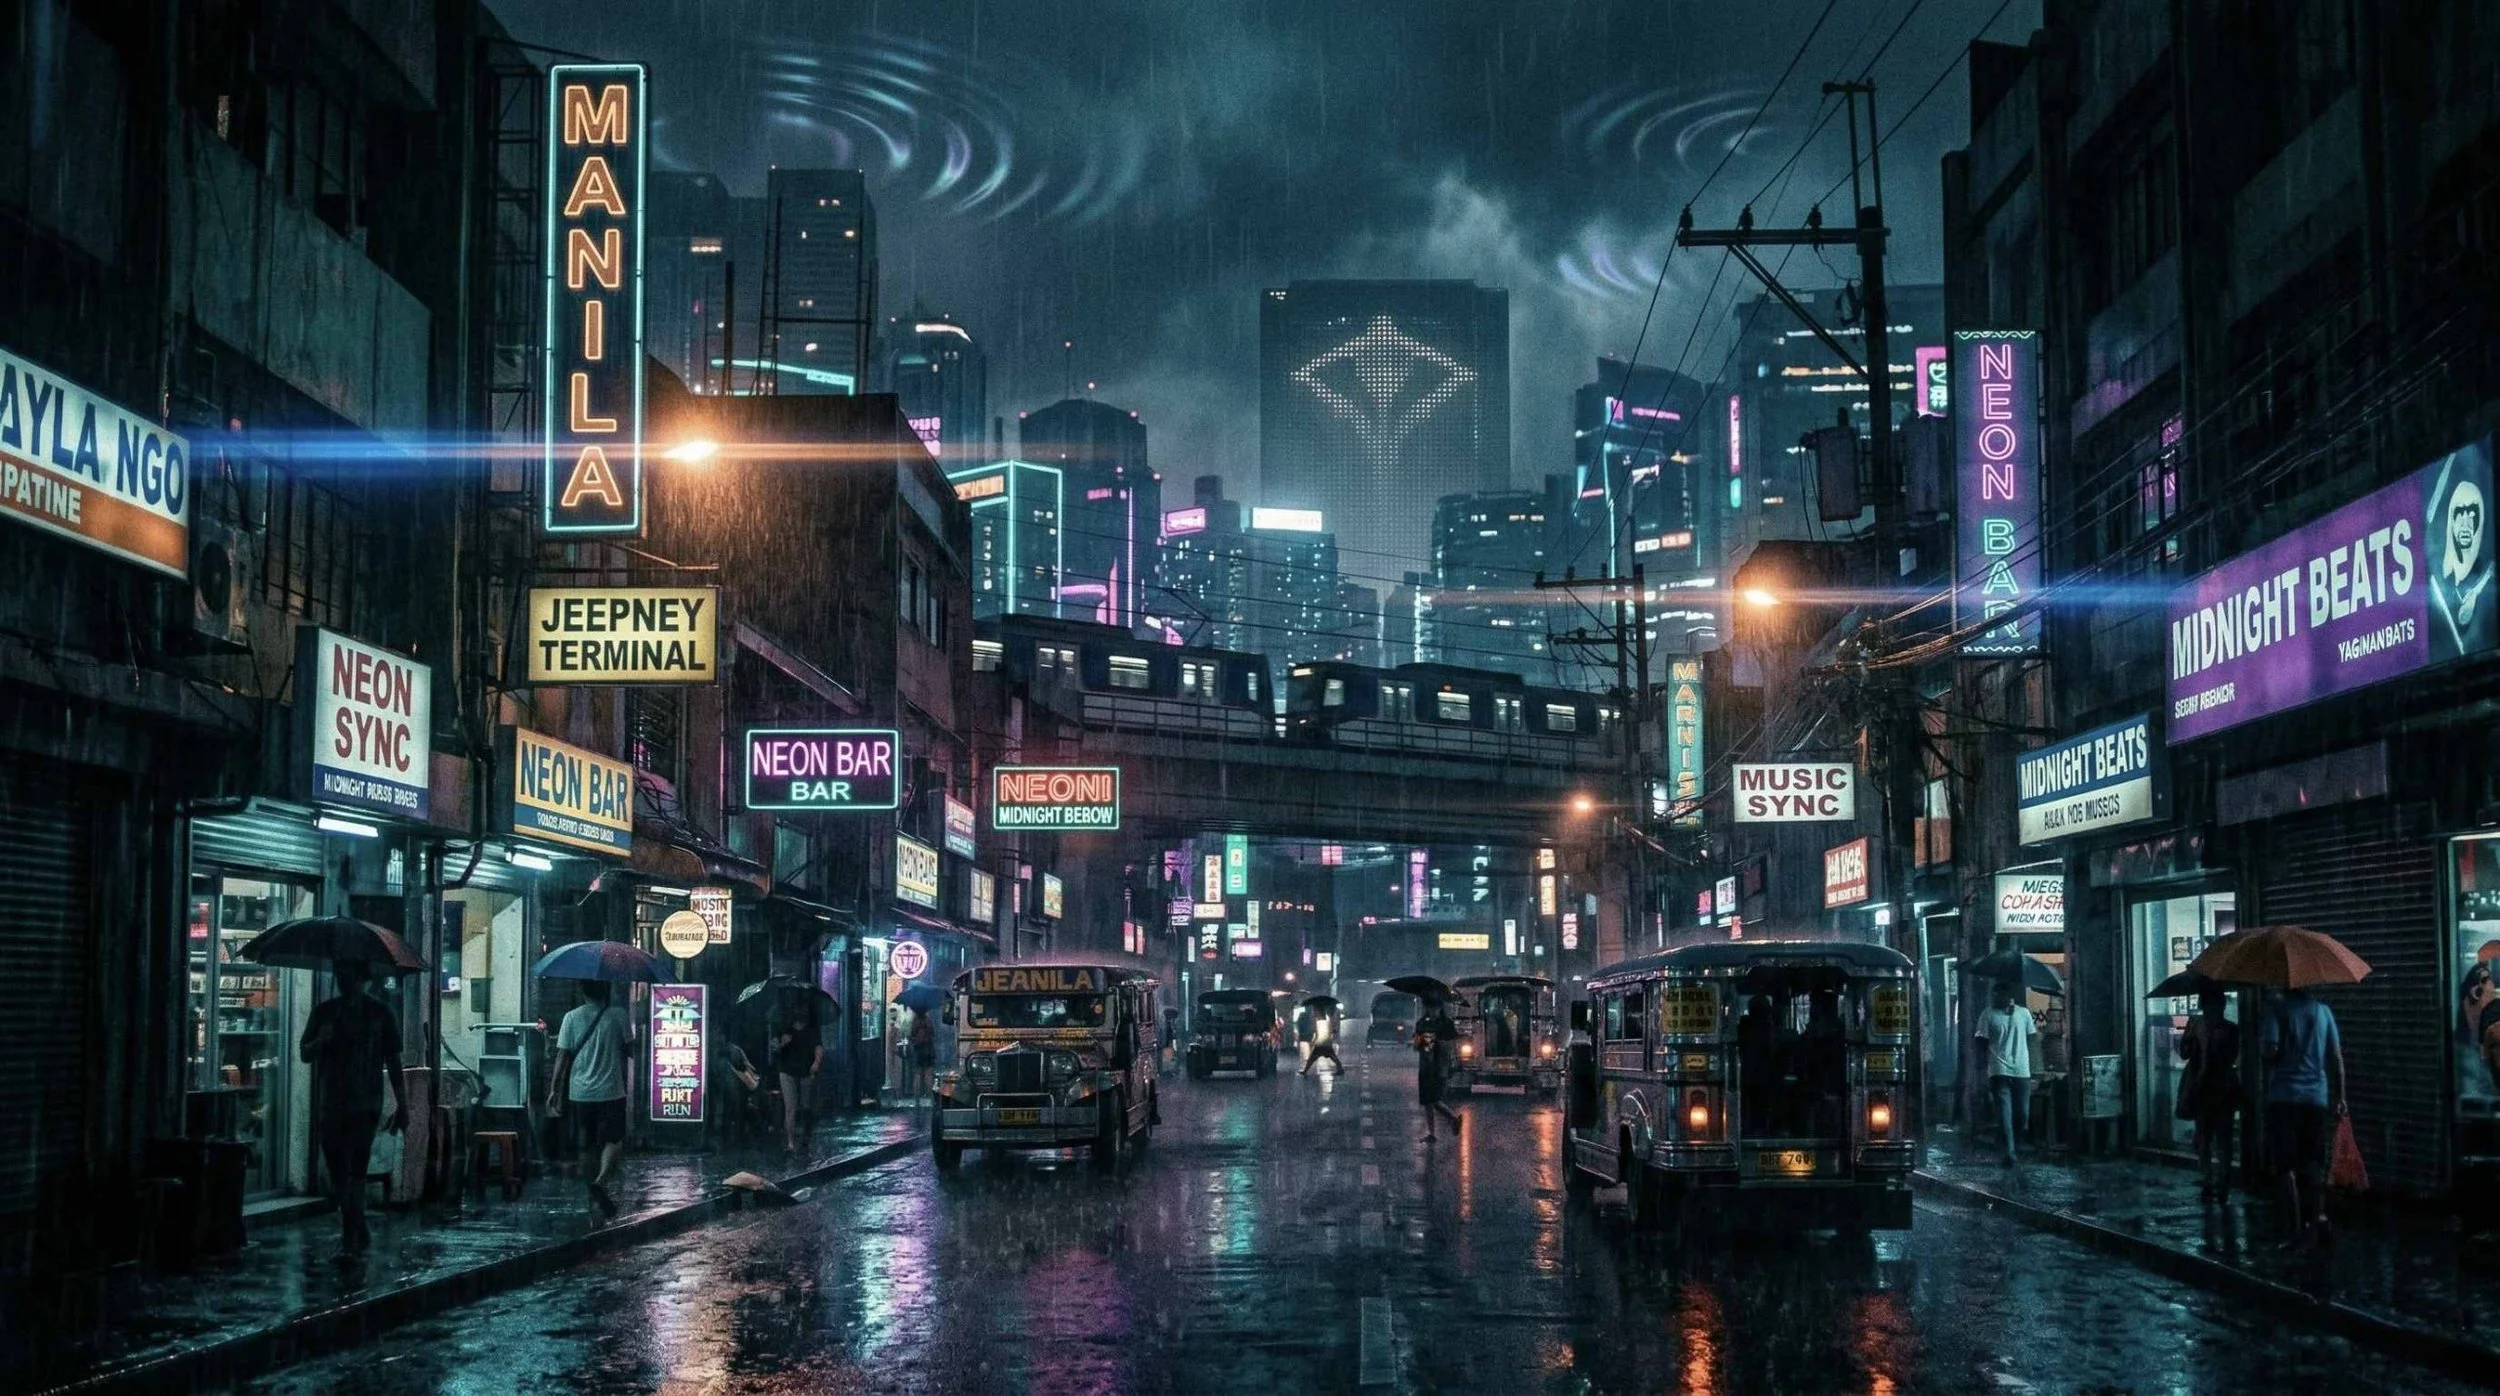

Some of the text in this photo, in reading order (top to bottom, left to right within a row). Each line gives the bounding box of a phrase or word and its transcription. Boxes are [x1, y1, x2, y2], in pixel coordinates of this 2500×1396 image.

[561, 84, 627, 507] MANILA
[116, 416, 184, 516] NGO
[1979, 343, 2020, 639] NEON BAR
[542, 598, 705, 632] JEEPNEY
[2173, 517, 2413, 681] MIDNIGHT BEATS
[539, 640, 706, 671] TERMINAL
[332, 643, 413, 717] NEON
[335, 705, 411, 773] SYNC
[753, 741, 892, 776] NEON BAR
[2020, 729, 2149, 800] MIDNIGHT BEATS
[520, 740, 629, 823] NEON BAR
[791, 781, 851, 802] BAR
[999, 774, 1113, 802] NEONI
[1739, 768, 1848, 791] MUSIC
[999, 806, 1063, 824] MIDNIGHT
[1747, 794, 1840, 817] SYNC
[976, 969, 1094, 991] JEANILA
